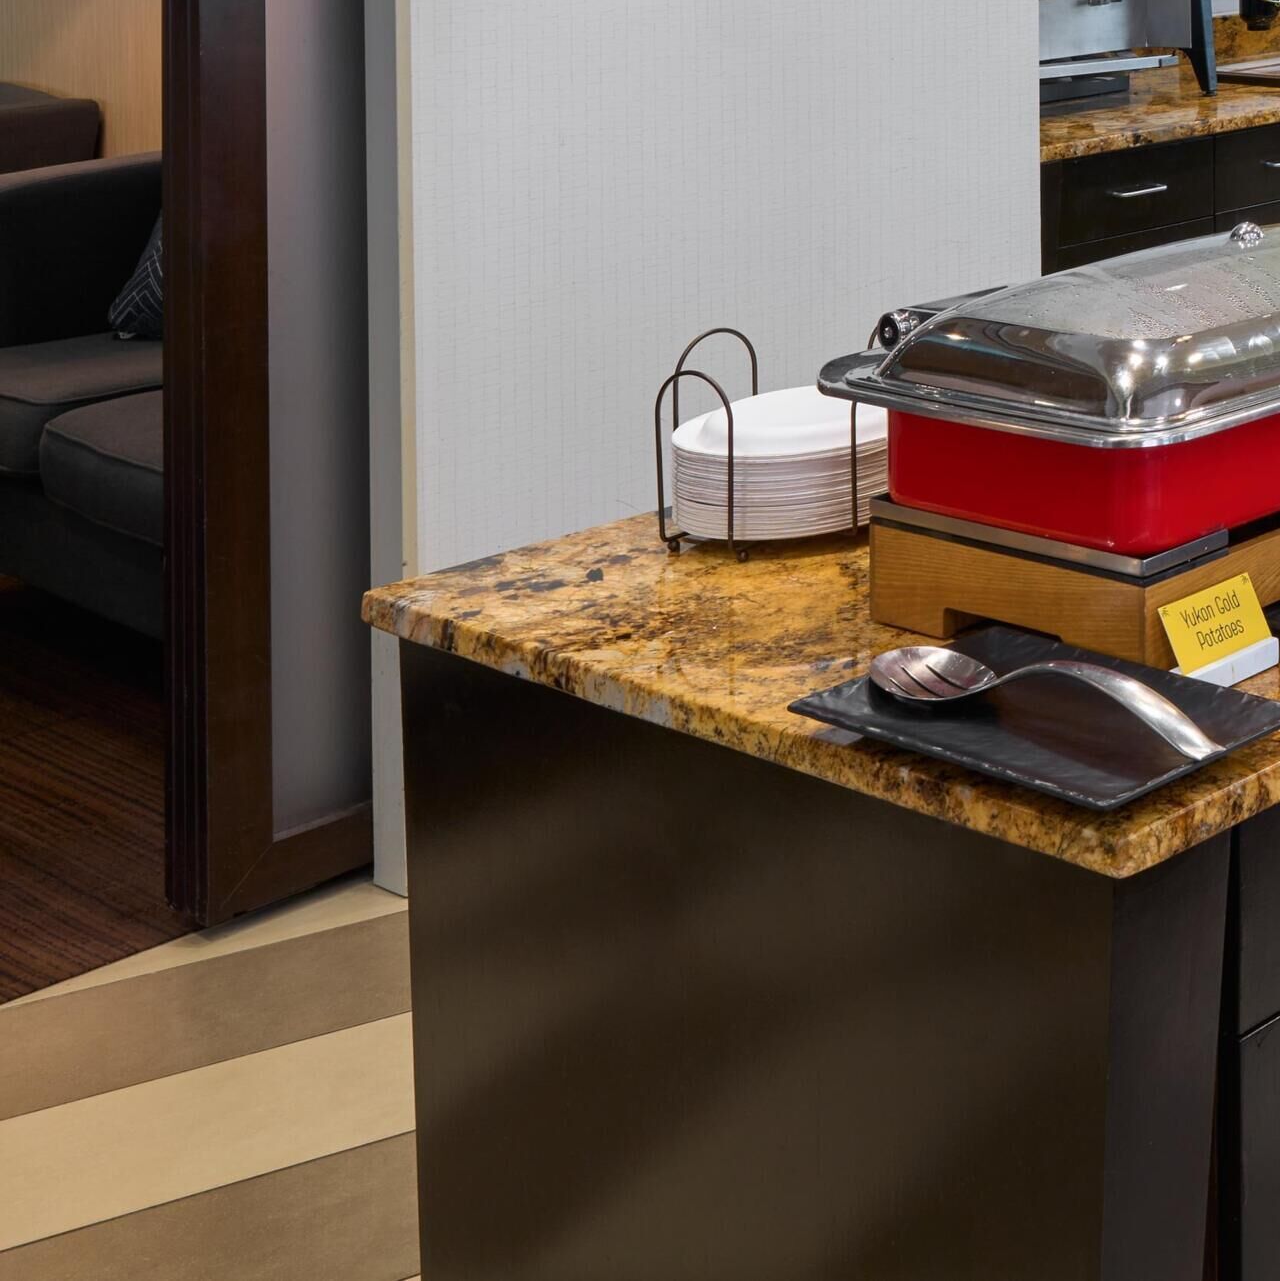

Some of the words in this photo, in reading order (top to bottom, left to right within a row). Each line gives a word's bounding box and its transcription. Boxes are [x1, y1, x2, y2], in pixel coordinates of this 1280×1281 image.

[1180, 604, 1216, 629] Yukon
[1214, 589, 1241, 615] Gold
[1196, 619, 1245, 651] Potatoes
